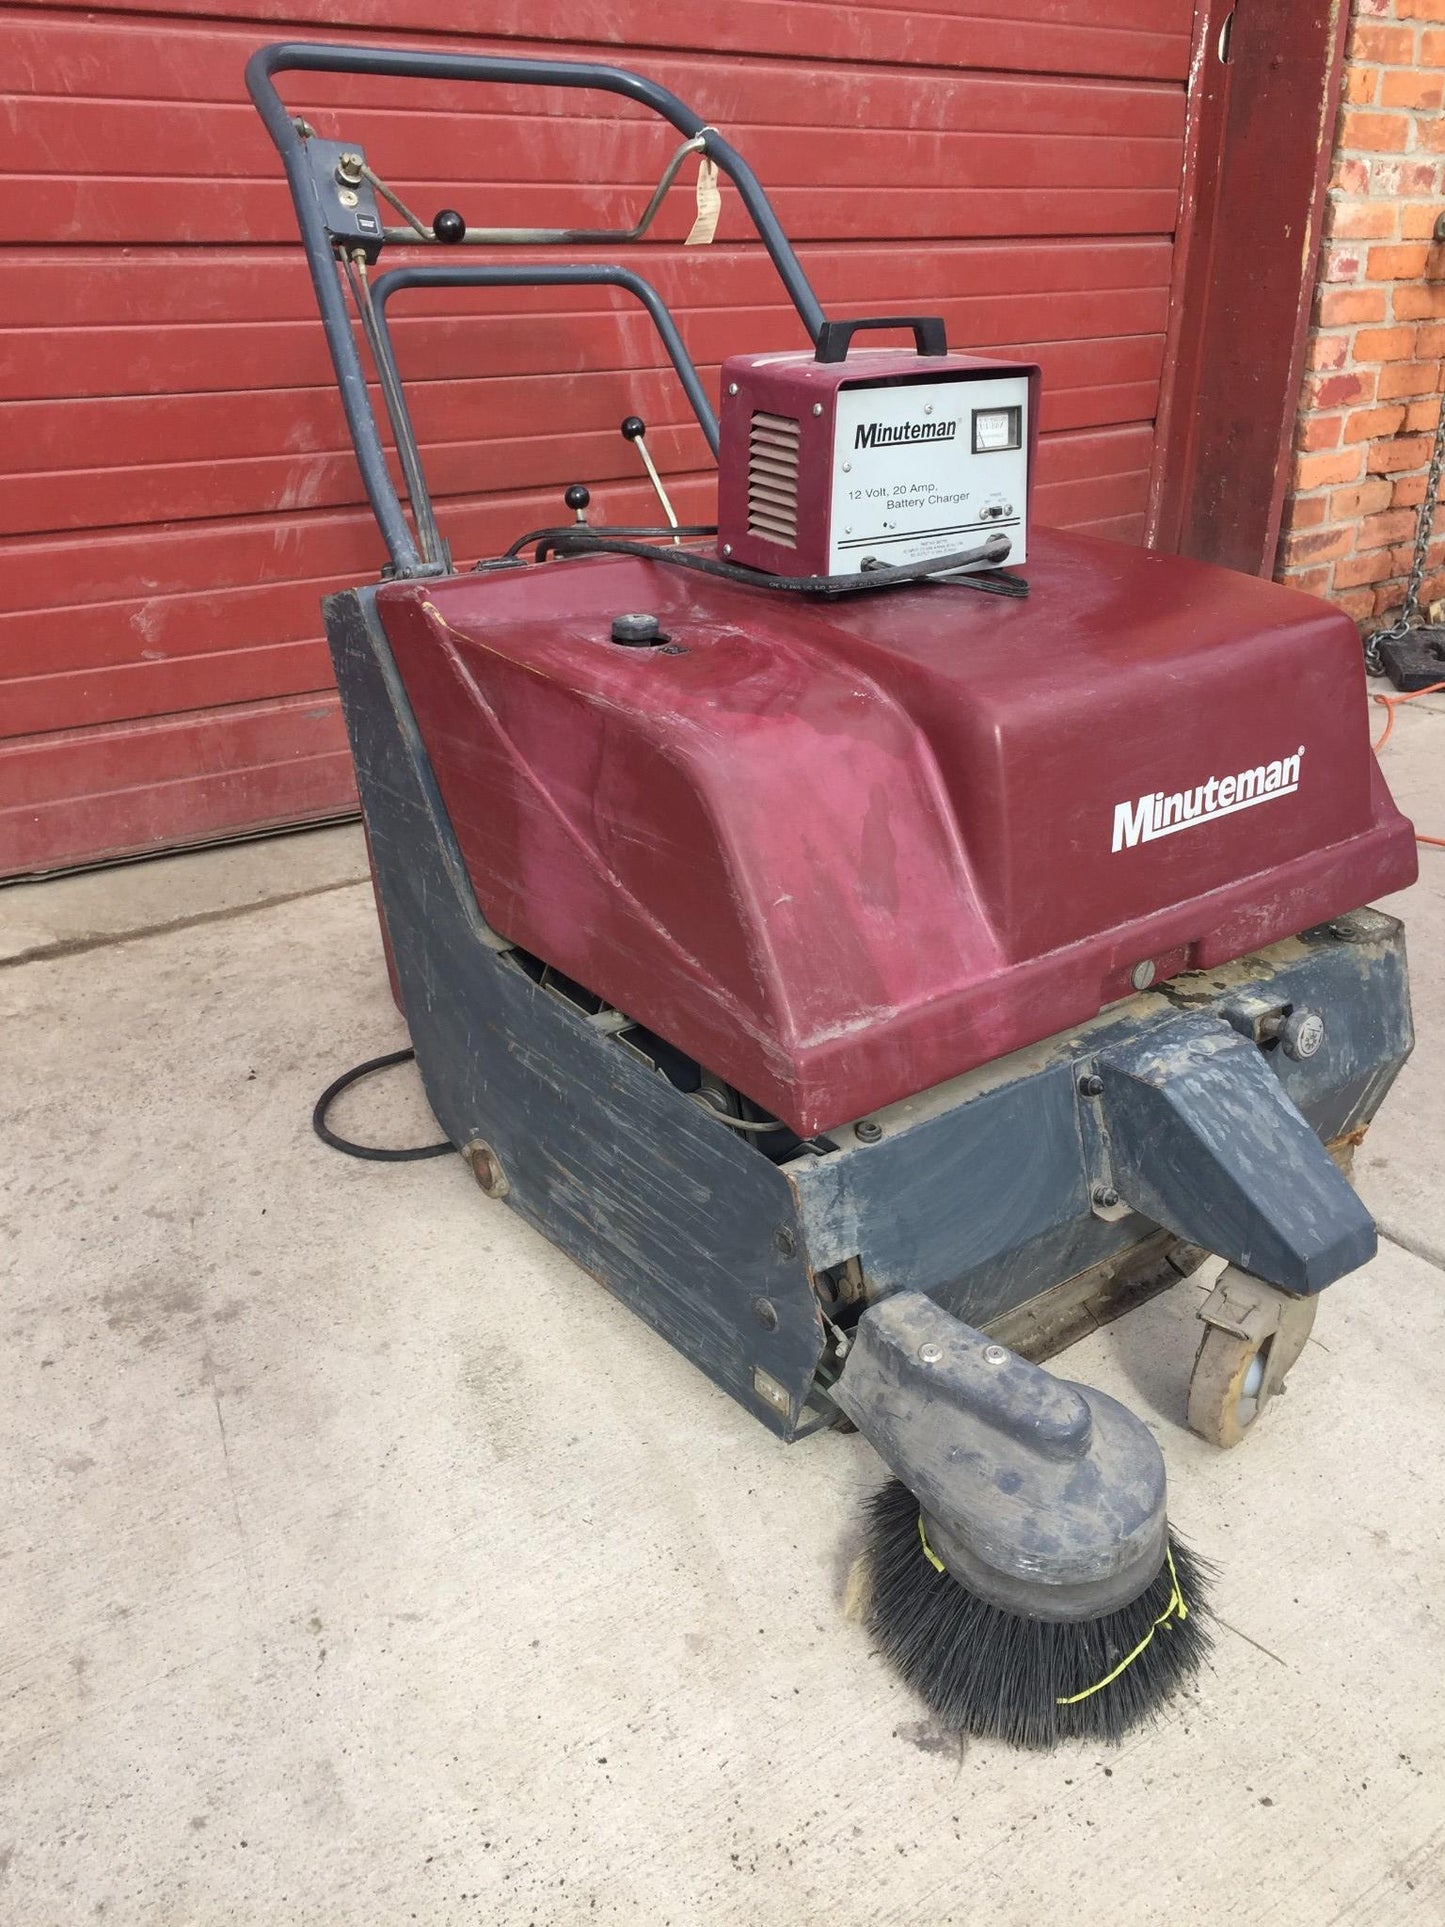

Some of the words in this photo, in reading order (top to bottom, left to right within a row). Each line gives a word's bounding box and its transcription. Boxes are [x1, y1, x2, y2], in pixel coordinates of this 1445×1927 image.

[854, 421, 957, 449] Minuteman
[848, 490, 862, 500] 12
[893, 485, 907, 496] 20
[886, 498, 925, 511] Battery
[928, 492, 970, 505] Charger
